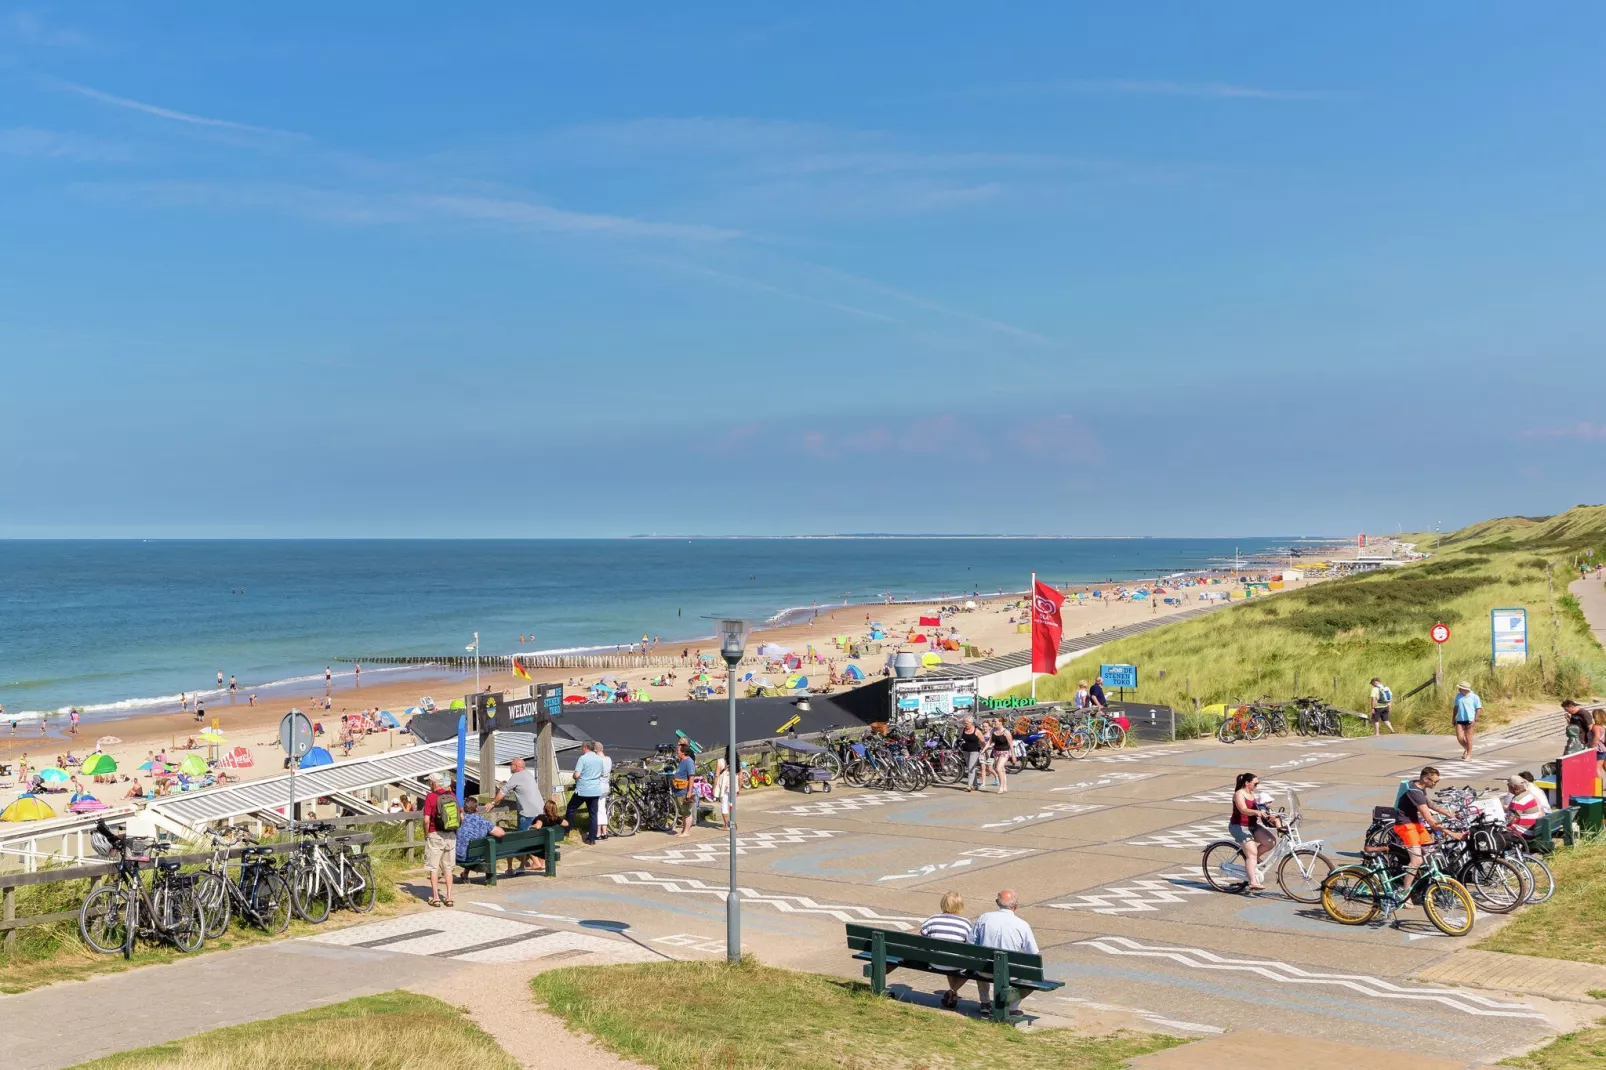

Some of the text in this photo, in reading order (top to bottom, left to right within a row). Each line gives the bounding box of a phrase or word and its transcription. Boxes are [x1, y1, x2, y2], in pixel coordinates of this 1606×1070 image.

[1104, 672, 1130, 680] STENEN
[508, 701, 538, 720] WELKOM
[977, 694, 1037, 711] eineken
